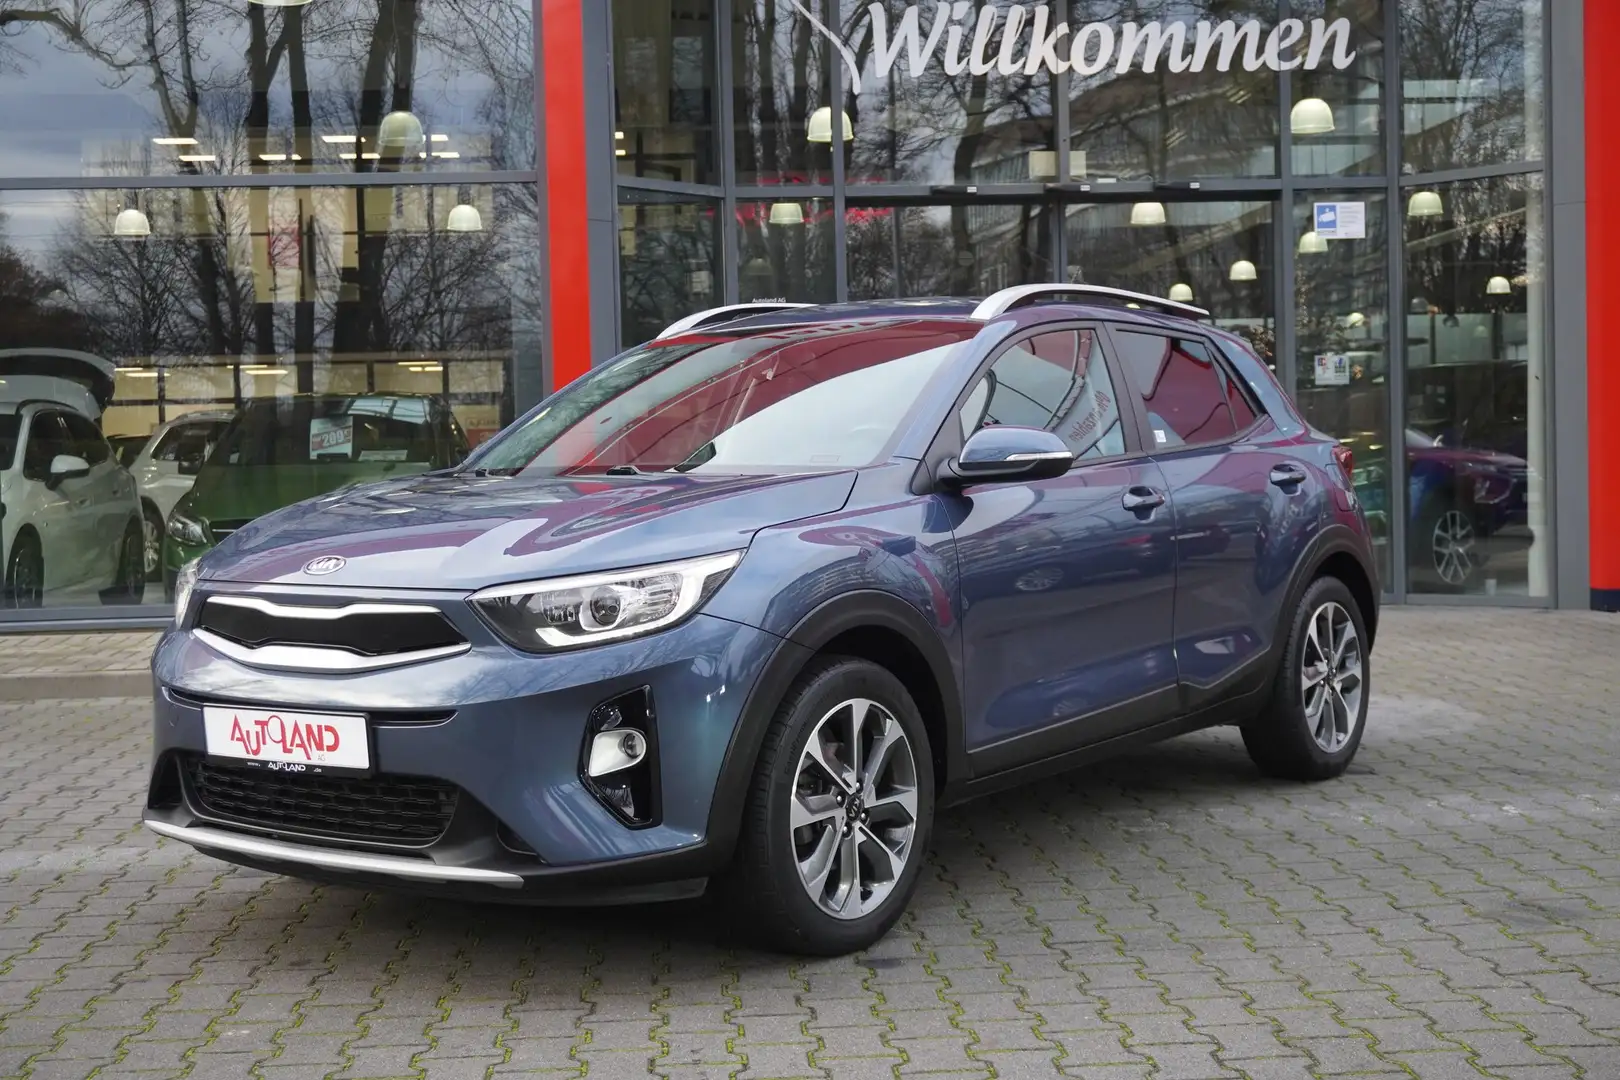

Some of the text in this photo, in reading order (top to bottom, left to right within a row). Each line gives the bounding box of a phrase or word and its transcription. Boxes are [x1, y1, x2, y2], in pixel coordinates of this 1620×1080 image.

[867, 1, 1356, 79] Willkommen
[230, 714, 340, 760] AUTOLAND
[268, 761, 306, 772] AUTOLAND
